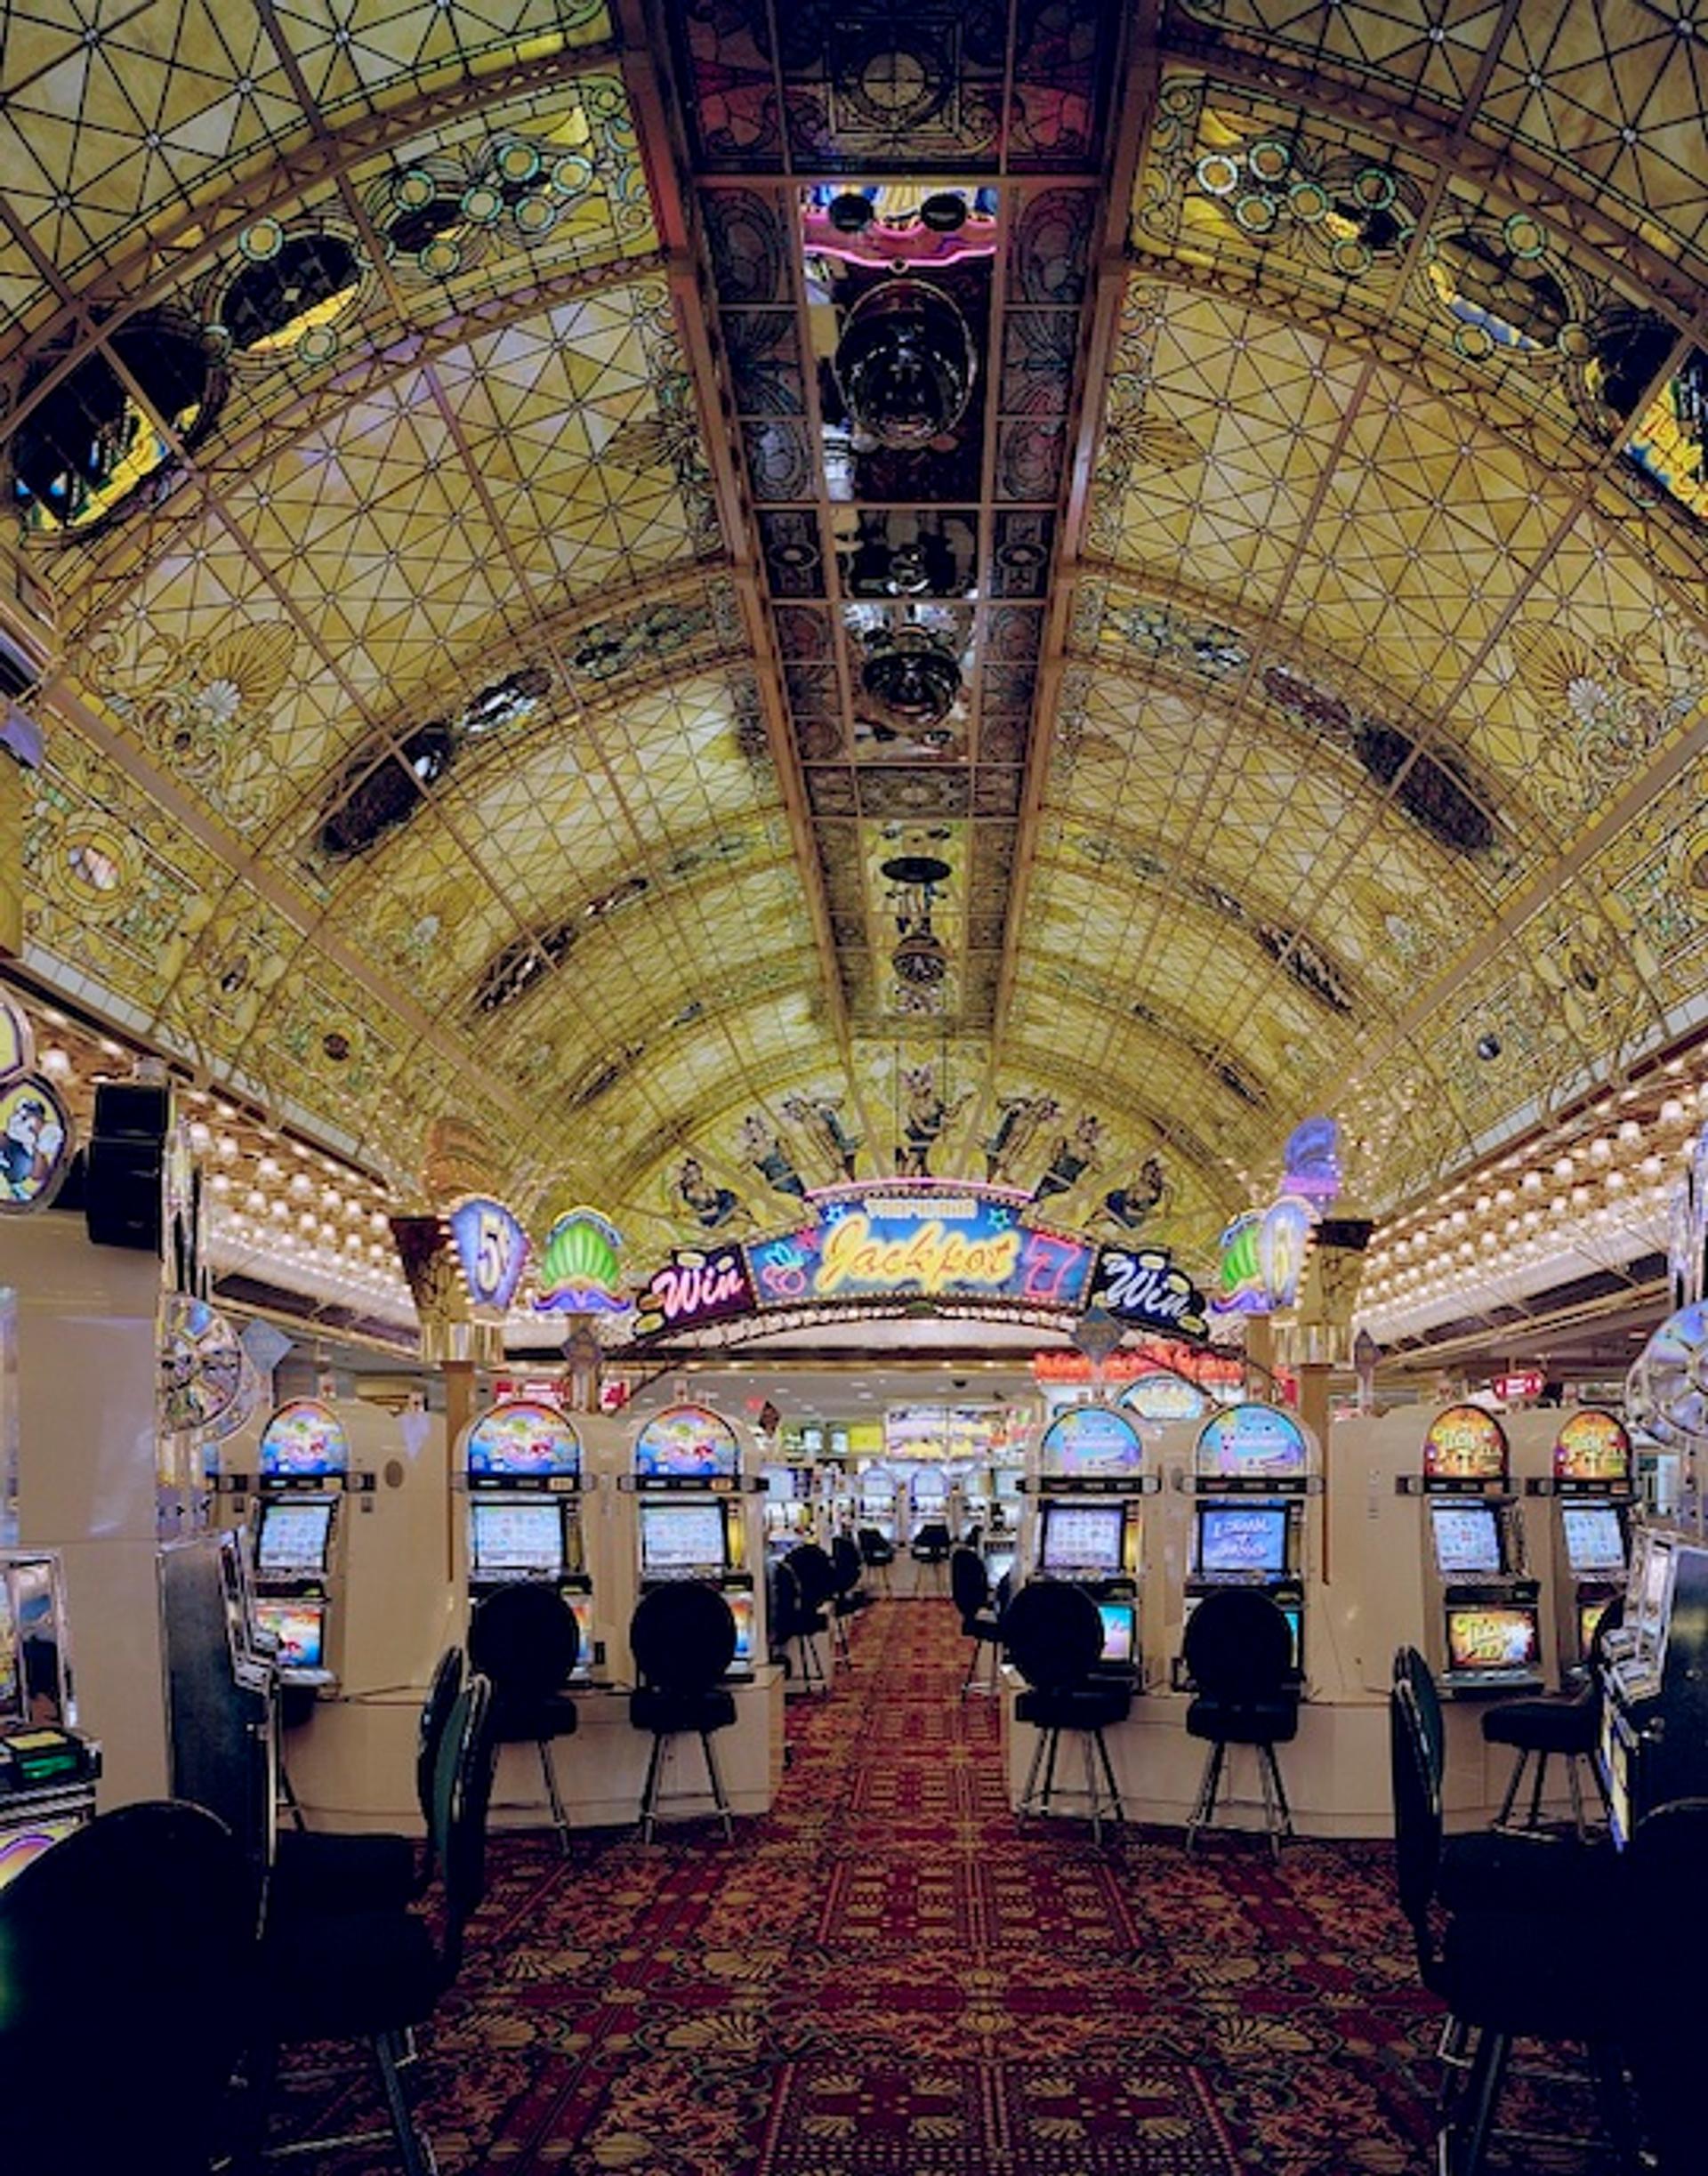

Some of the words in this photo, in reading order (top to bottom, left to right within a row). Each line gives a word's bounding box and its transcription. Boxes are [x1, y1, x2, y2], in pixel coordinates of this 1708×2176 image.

[815, 1215, 1019, 1292] Jackpot
[652, 1265, 744, 1317] Win
[1105, 1261, 1190, 1317] Win
